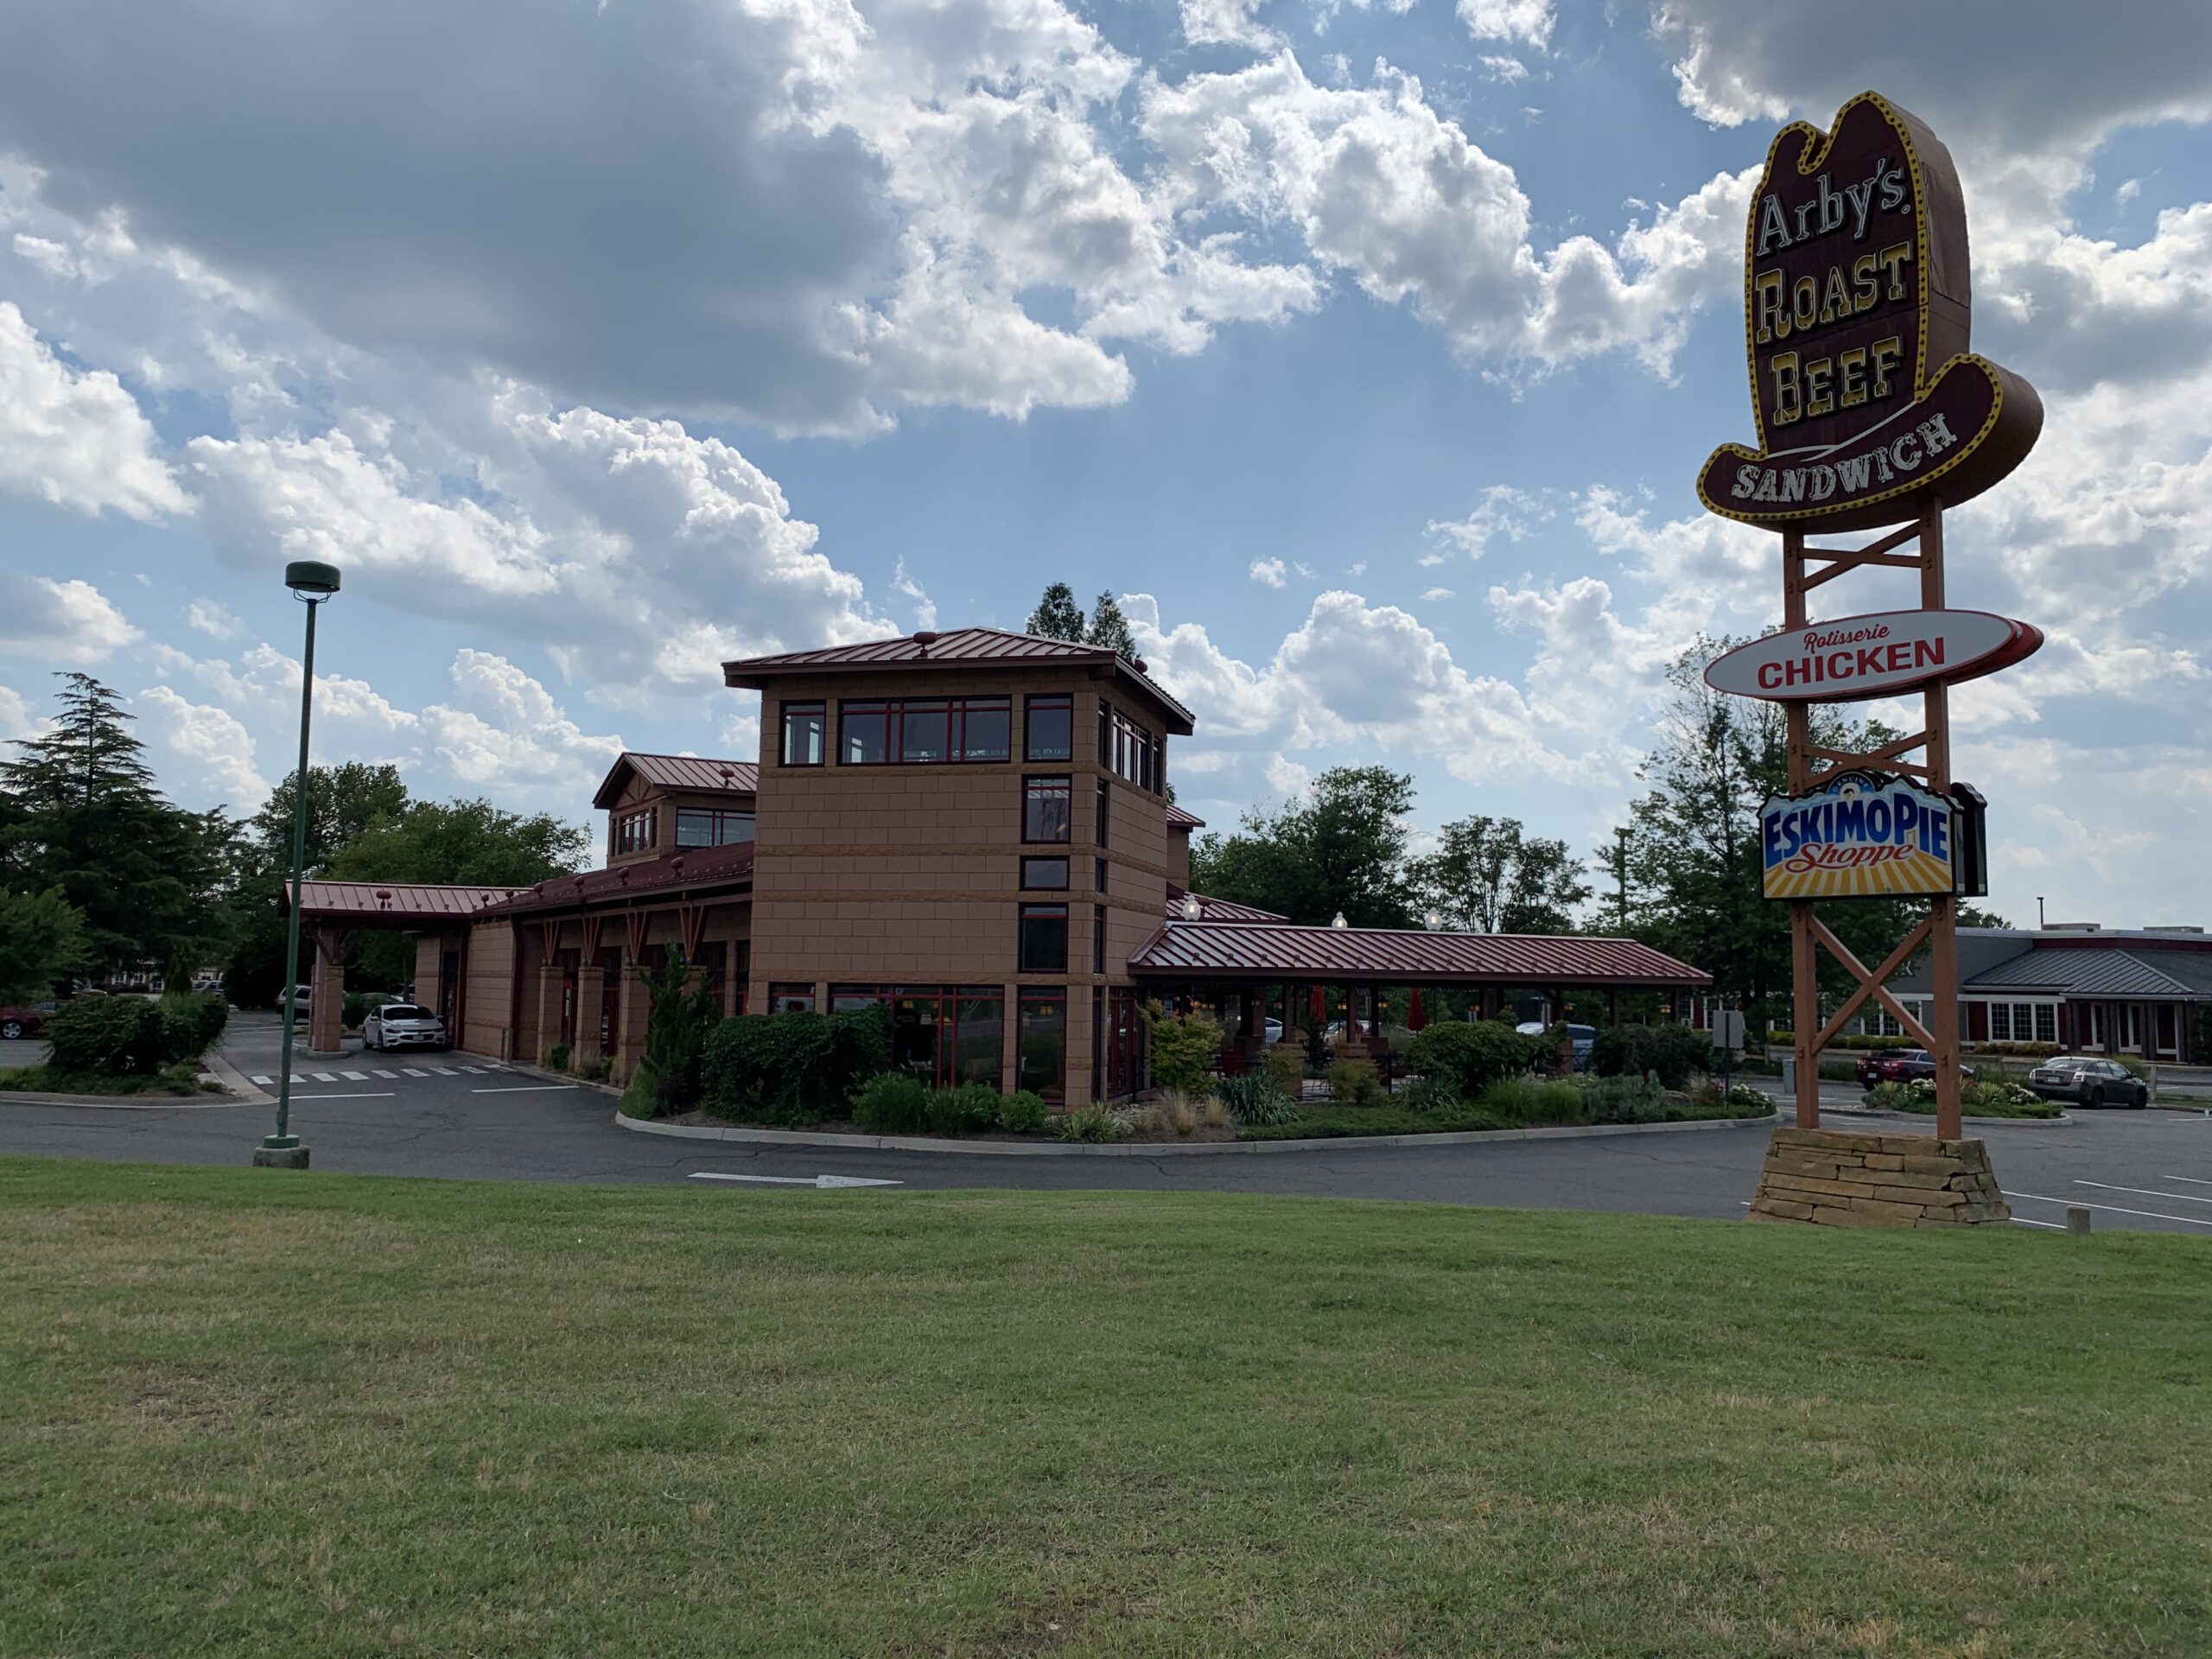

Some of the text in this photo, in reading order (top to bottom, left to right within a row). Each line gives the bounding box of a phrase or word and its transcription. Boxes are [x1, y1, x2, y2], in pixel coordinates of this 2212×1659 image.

[1757, 158, 1904, 256] Arby's
[1756, 241, 1913, 344] ROAST
[1770, 335, 1903, 426] BEEF
[1732, 413, 1958, 503] SANDWICH
[1758, 637, 1945, 690] CHICKEN
[1803, 624, 1891, 654] Rotisserie
[1832, 776, 1869, 792] GENUINE
[1784, 842, 1914, 873] Shoppe
